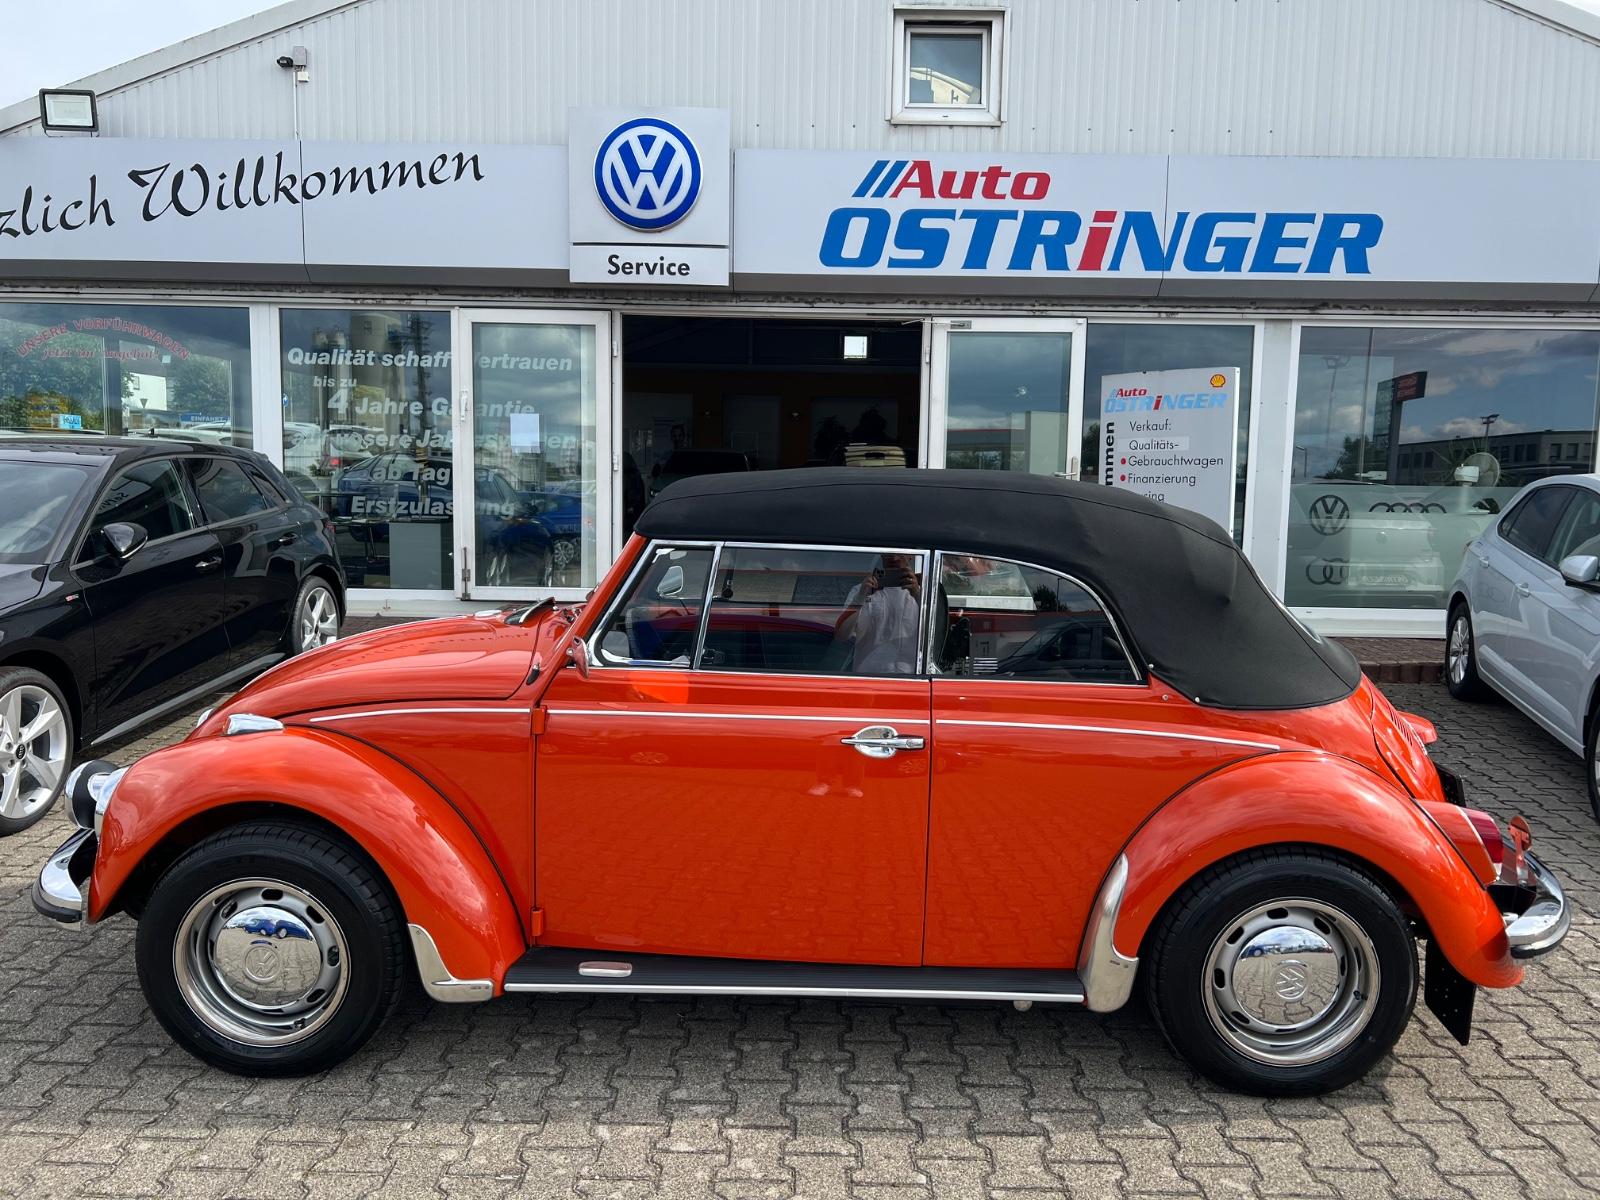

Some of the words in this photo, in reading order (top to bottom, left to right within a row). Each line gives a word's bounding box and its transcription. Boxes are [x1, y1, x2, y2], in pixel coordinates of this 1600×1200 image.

[127, 151, 485, 221] Willkommen
[891, 160, 1051, 200] Auto
[607, 255, 691, 279] Service
[16, 323, 67, 358] UNSERE
[73, 317, 191, 360] VORFÜHRWAGEN
[287, 348, 375, 368] Qualität
[381, 350, 453, 369] schaff
[478, 352, 573, 372] ertrauen
[313, 375, 336, 388] bis
[340, 377, 357, 388] zu
[1116, 388, 1148, 398] Auto
[328, 389, 349, 414] 4
[355, 397, 424, 416] Jahre
[431, 397, 535, 418] Gantie
[1129, 418, 1172, 432] Verkauf:
[1129, 439, 1180, 451] Qualitäts-
[1128, 455, 1224, 469] Gebrauchtwagen
[373, 465, 404, 481] ab
[1127, 471, 1197, 486] Finanzierung
